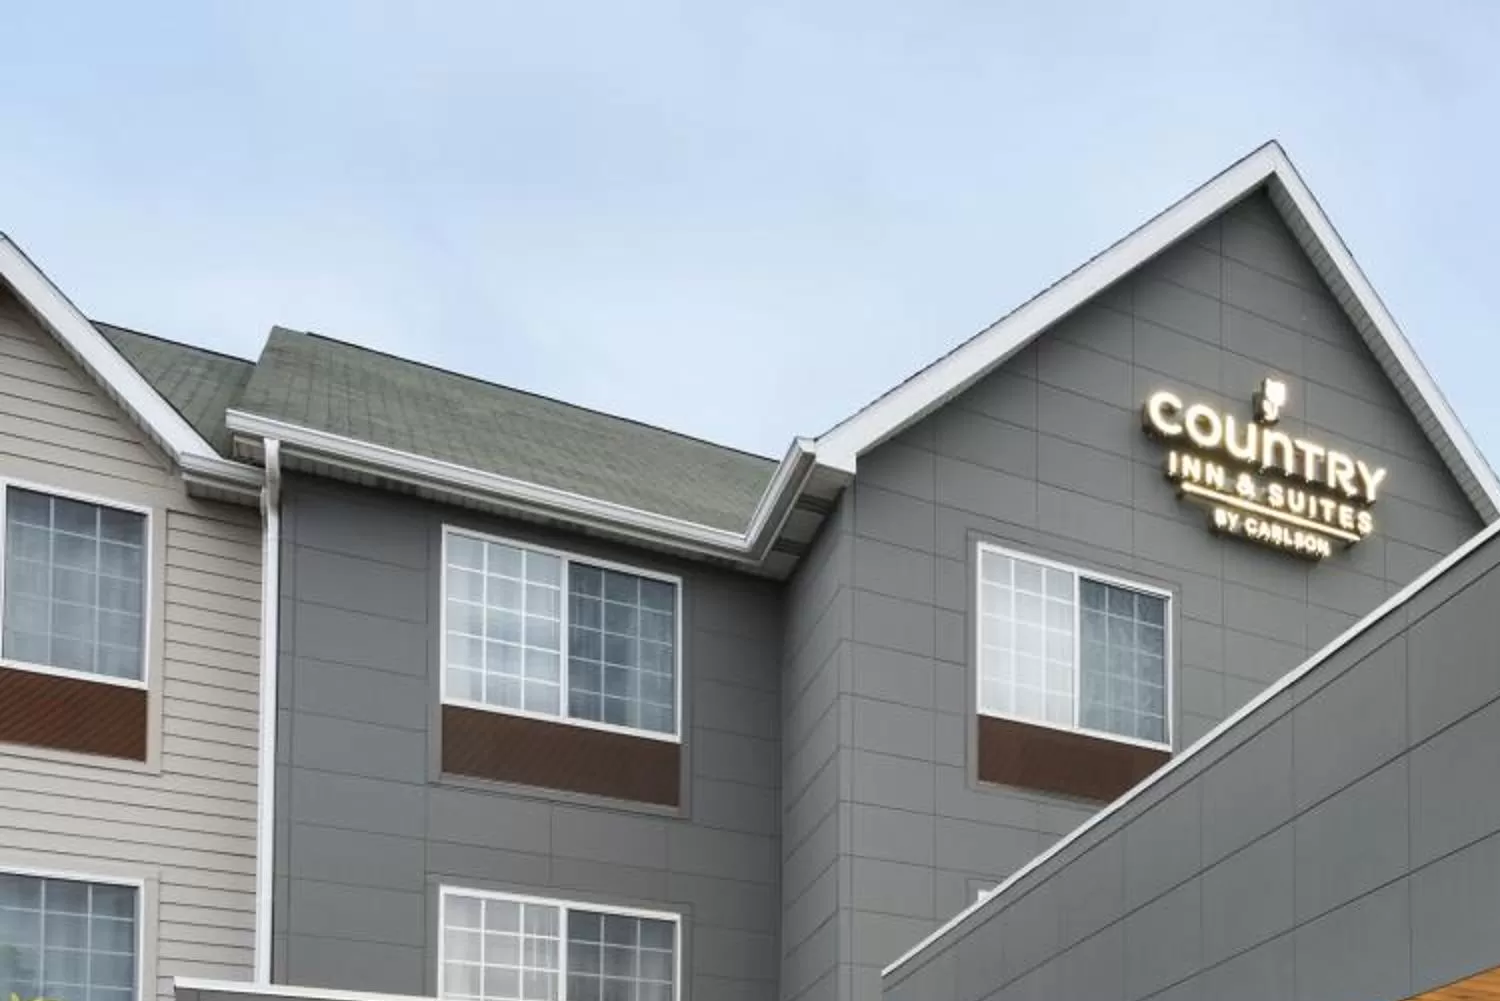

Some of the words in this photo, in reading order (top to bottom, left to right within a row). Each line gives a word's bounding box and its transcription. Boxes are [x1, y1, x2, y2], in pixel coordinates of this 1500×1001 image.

[1168, 451, 1224, 488] INN
[1236, 472, 1256, 498] &
[1267, 483, 1374, 534] SUITES
[1213, 508, 1238, 530] BY
[1244, 518, 1331, 557] CARLSON
